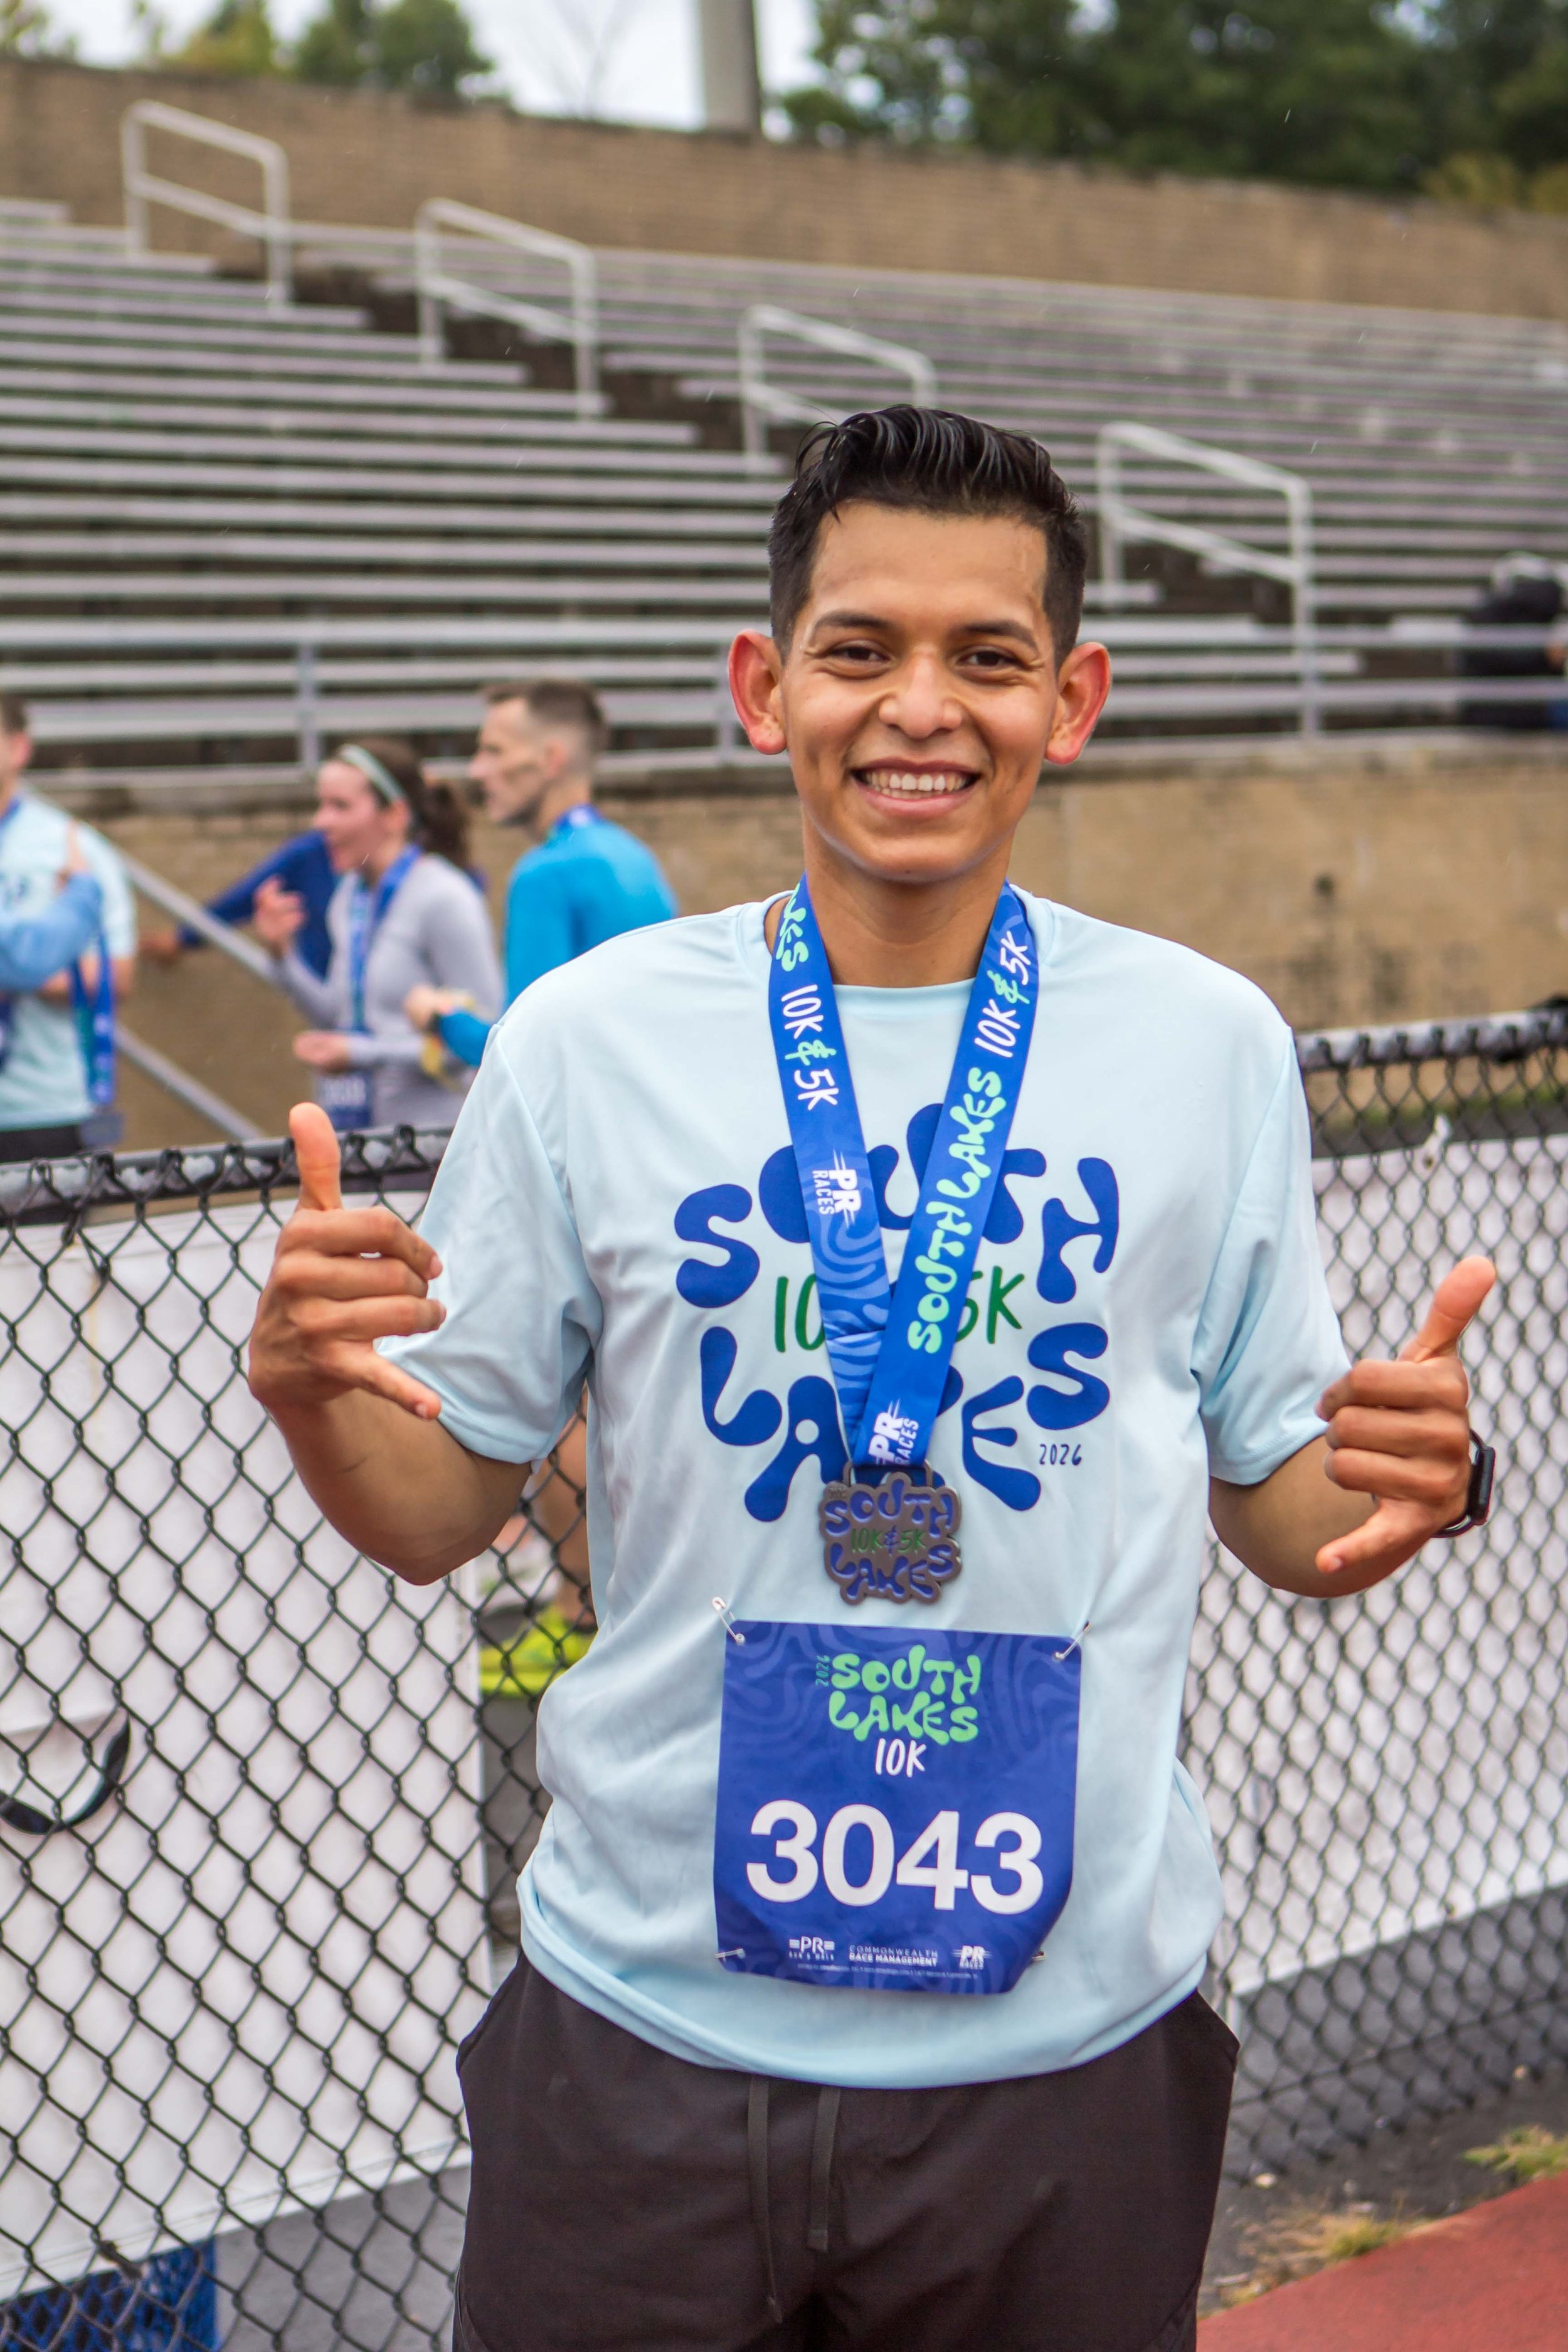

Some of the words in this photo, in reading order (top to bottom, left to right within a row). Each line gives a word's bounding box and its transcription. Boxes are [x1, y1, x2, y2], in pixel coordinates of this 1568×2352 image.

[1000, 930, 1032, 986] 5K
[987, 970, 1030, 1004] &
[781, 984, 824, 1039] 10K
[974, 999, 1020, 1057] 10K
[785, 1039, 837, 1066] &
[793, 1068, 839, 1111] 5K
[936, 1067, 1006, 1199] LAKES
[812, 1168, 835, 1216] RACES
[828, 1168, 862, 1214] PR
[908, 1201, 973, 1354] SOUTH
[700, 1322, 1110, 1522] LAES
[869, 1412, 904, 1463] PR
[1039, 1443, 1082, 1466] 2026
[824, 1478, 953, 1538] SOUTH
[850, 1528, 883, 1554] 10K
[898, 1528, 926, 1554] 5K
[829, 1542, 953, 1599] LAKES
[816, 1655, 830, 1687] 2026
[831, 1645, 982, 1705] SOUTH
[829, 1690, 978, 1745] LAKES
[875, 1738, 927, 1777] 10K
[746, 1799, 1044, 1915] 3043
[800, 1936, 825, 1955] PR
[849, 1944, 938, 1958] COMMONWEALTH
[849, 1952, 873, 1963] RACE
[876, 1954, 938, 1967] MANAGEMENT
[961, 1945, 985, 1959] PR
